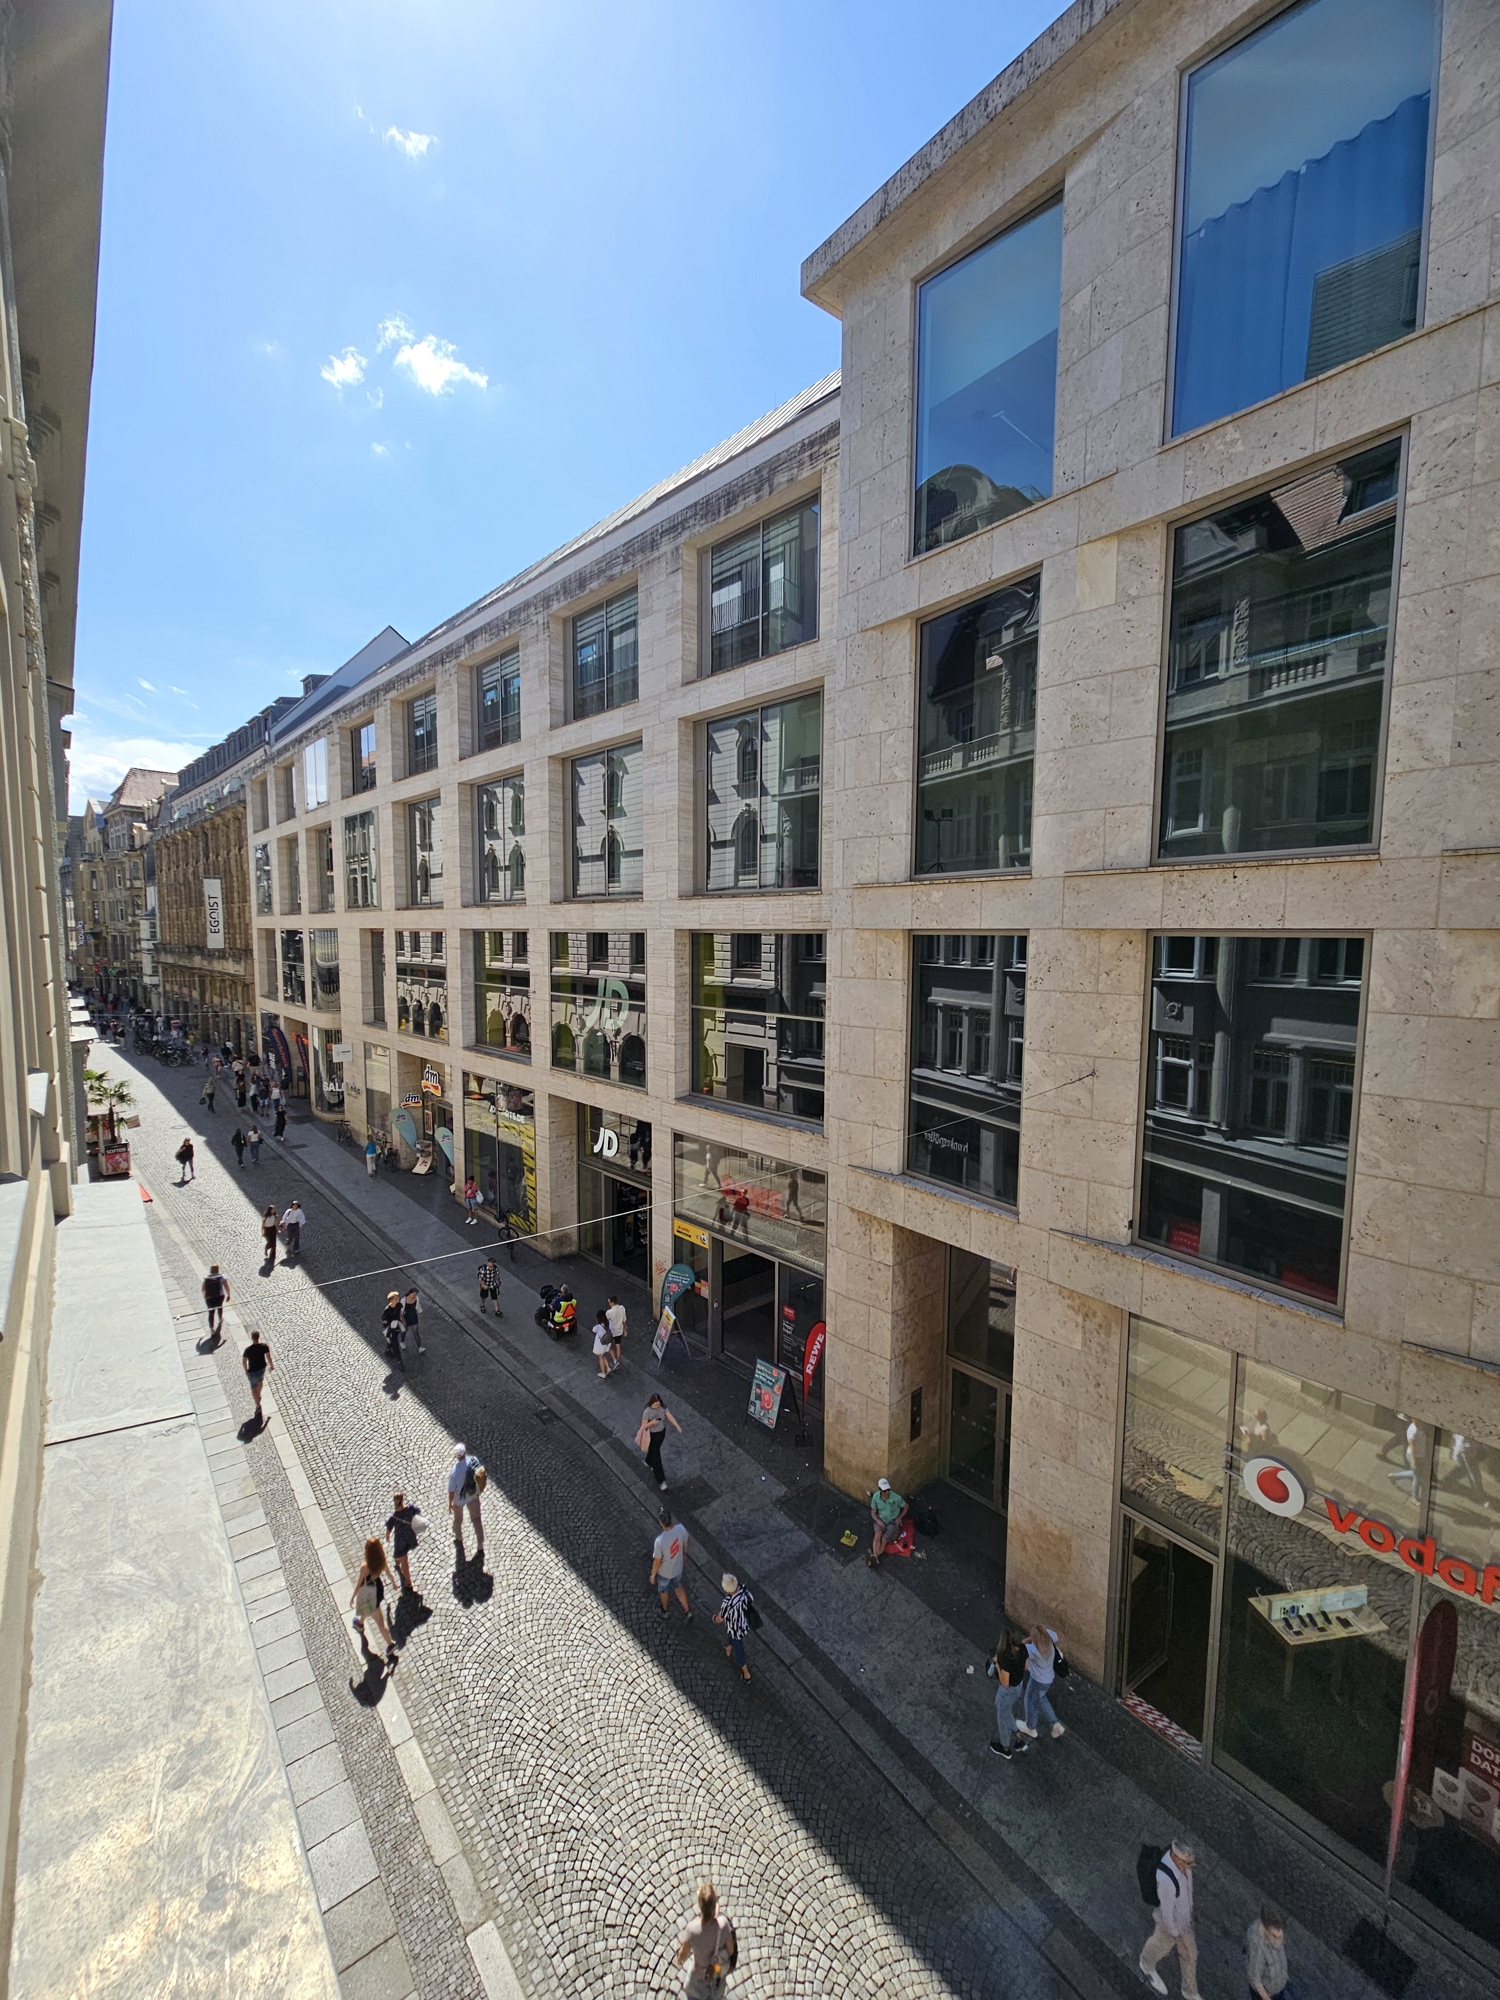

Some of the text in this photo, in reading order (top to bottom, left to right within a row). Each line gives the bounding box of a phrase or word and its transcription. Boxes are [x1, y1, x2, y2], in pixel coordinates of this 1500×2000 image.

[207, 894, 221, 935] EGOIST
[586, 978, 630, 1032] JD
[424, 1065, 439, 1085] dm
[405, 1094, 419, 1103] dm
[593, 1127, 619, 1158] JD
[805, 1333, 825, 1375] REWE
[1324, 1498, 1500, 1606] vodaf
